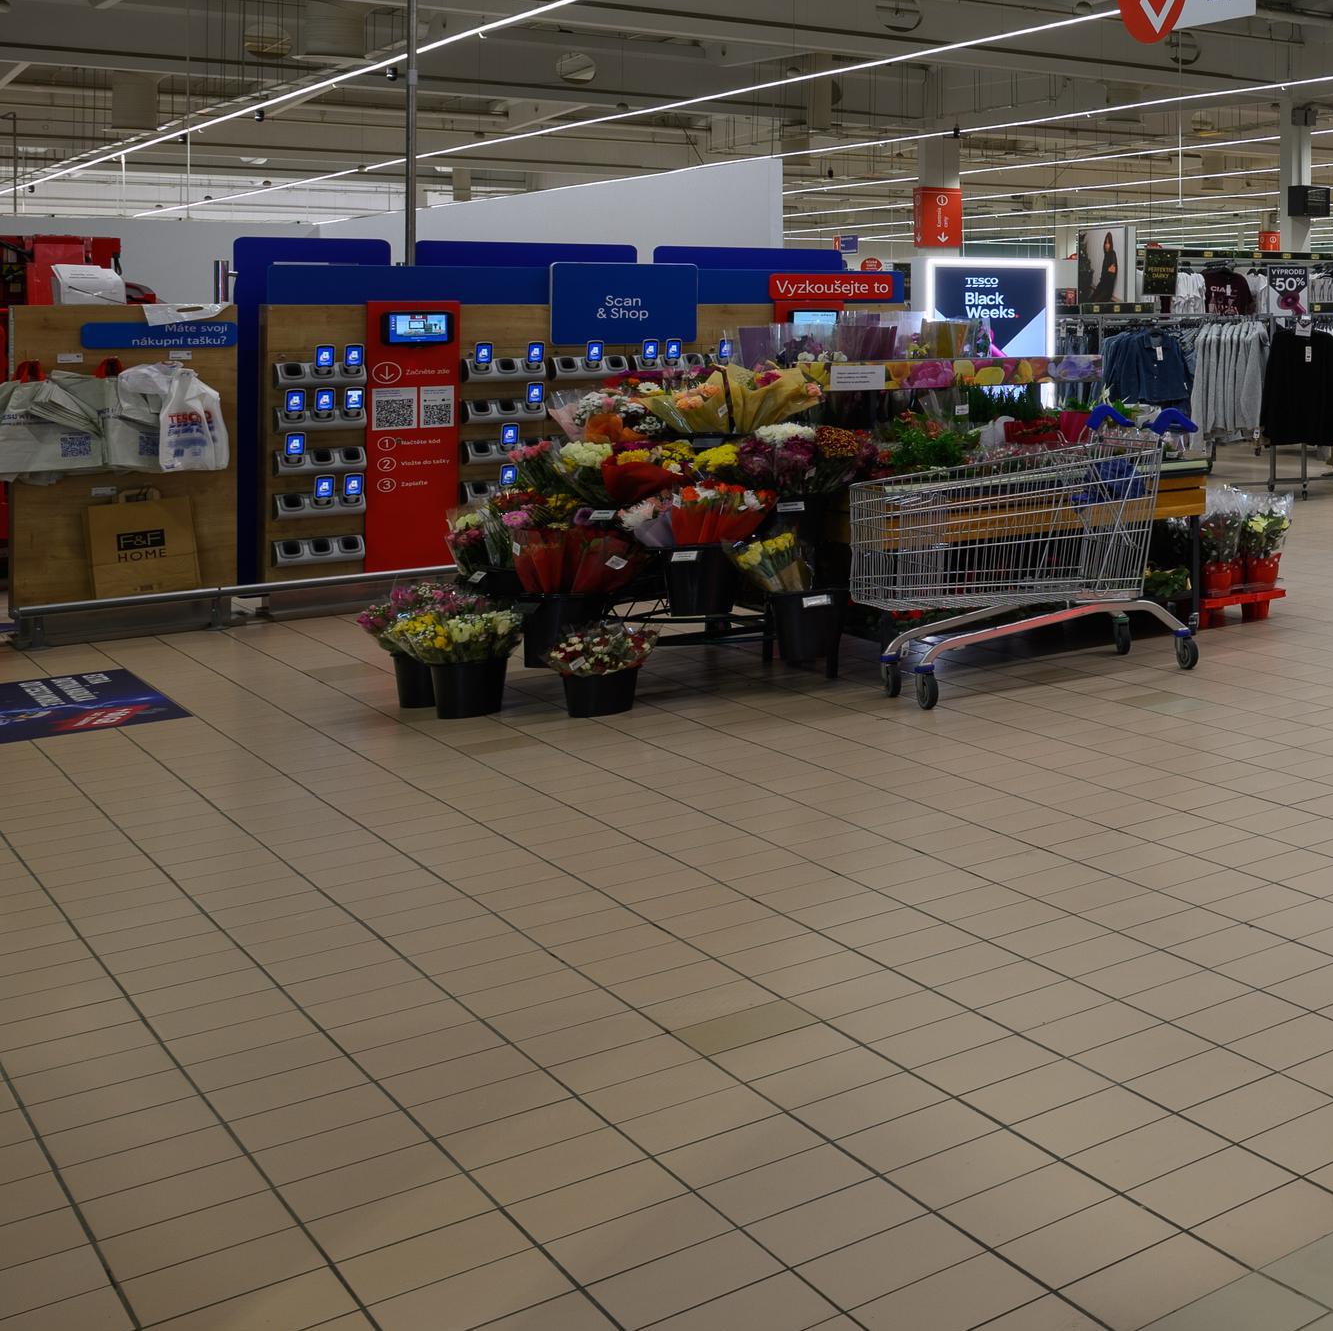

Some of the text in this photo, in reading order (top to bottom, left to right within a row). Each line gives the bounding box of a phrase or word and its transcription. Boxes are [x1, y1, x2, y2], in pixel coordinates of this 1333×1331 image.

[776, 279, 889, 297] Vyzkoušejte to
[965, 277, 999, 286] TESCO
[1272, 277, 1305, 291] -50%
[605, 295, 641, 308] Scan
[965, 292, 1004, 305] Black
[597, 307, 649, 321] & Shop
[965, 306, 1020, 319] Weeks.
[165, 323, 228, 335] Máte svoji
[131, 335, 227, 348] nákupní tašku?
[120, 531, 162, 549] F&F
[118, 549, 168, 563] HOME
